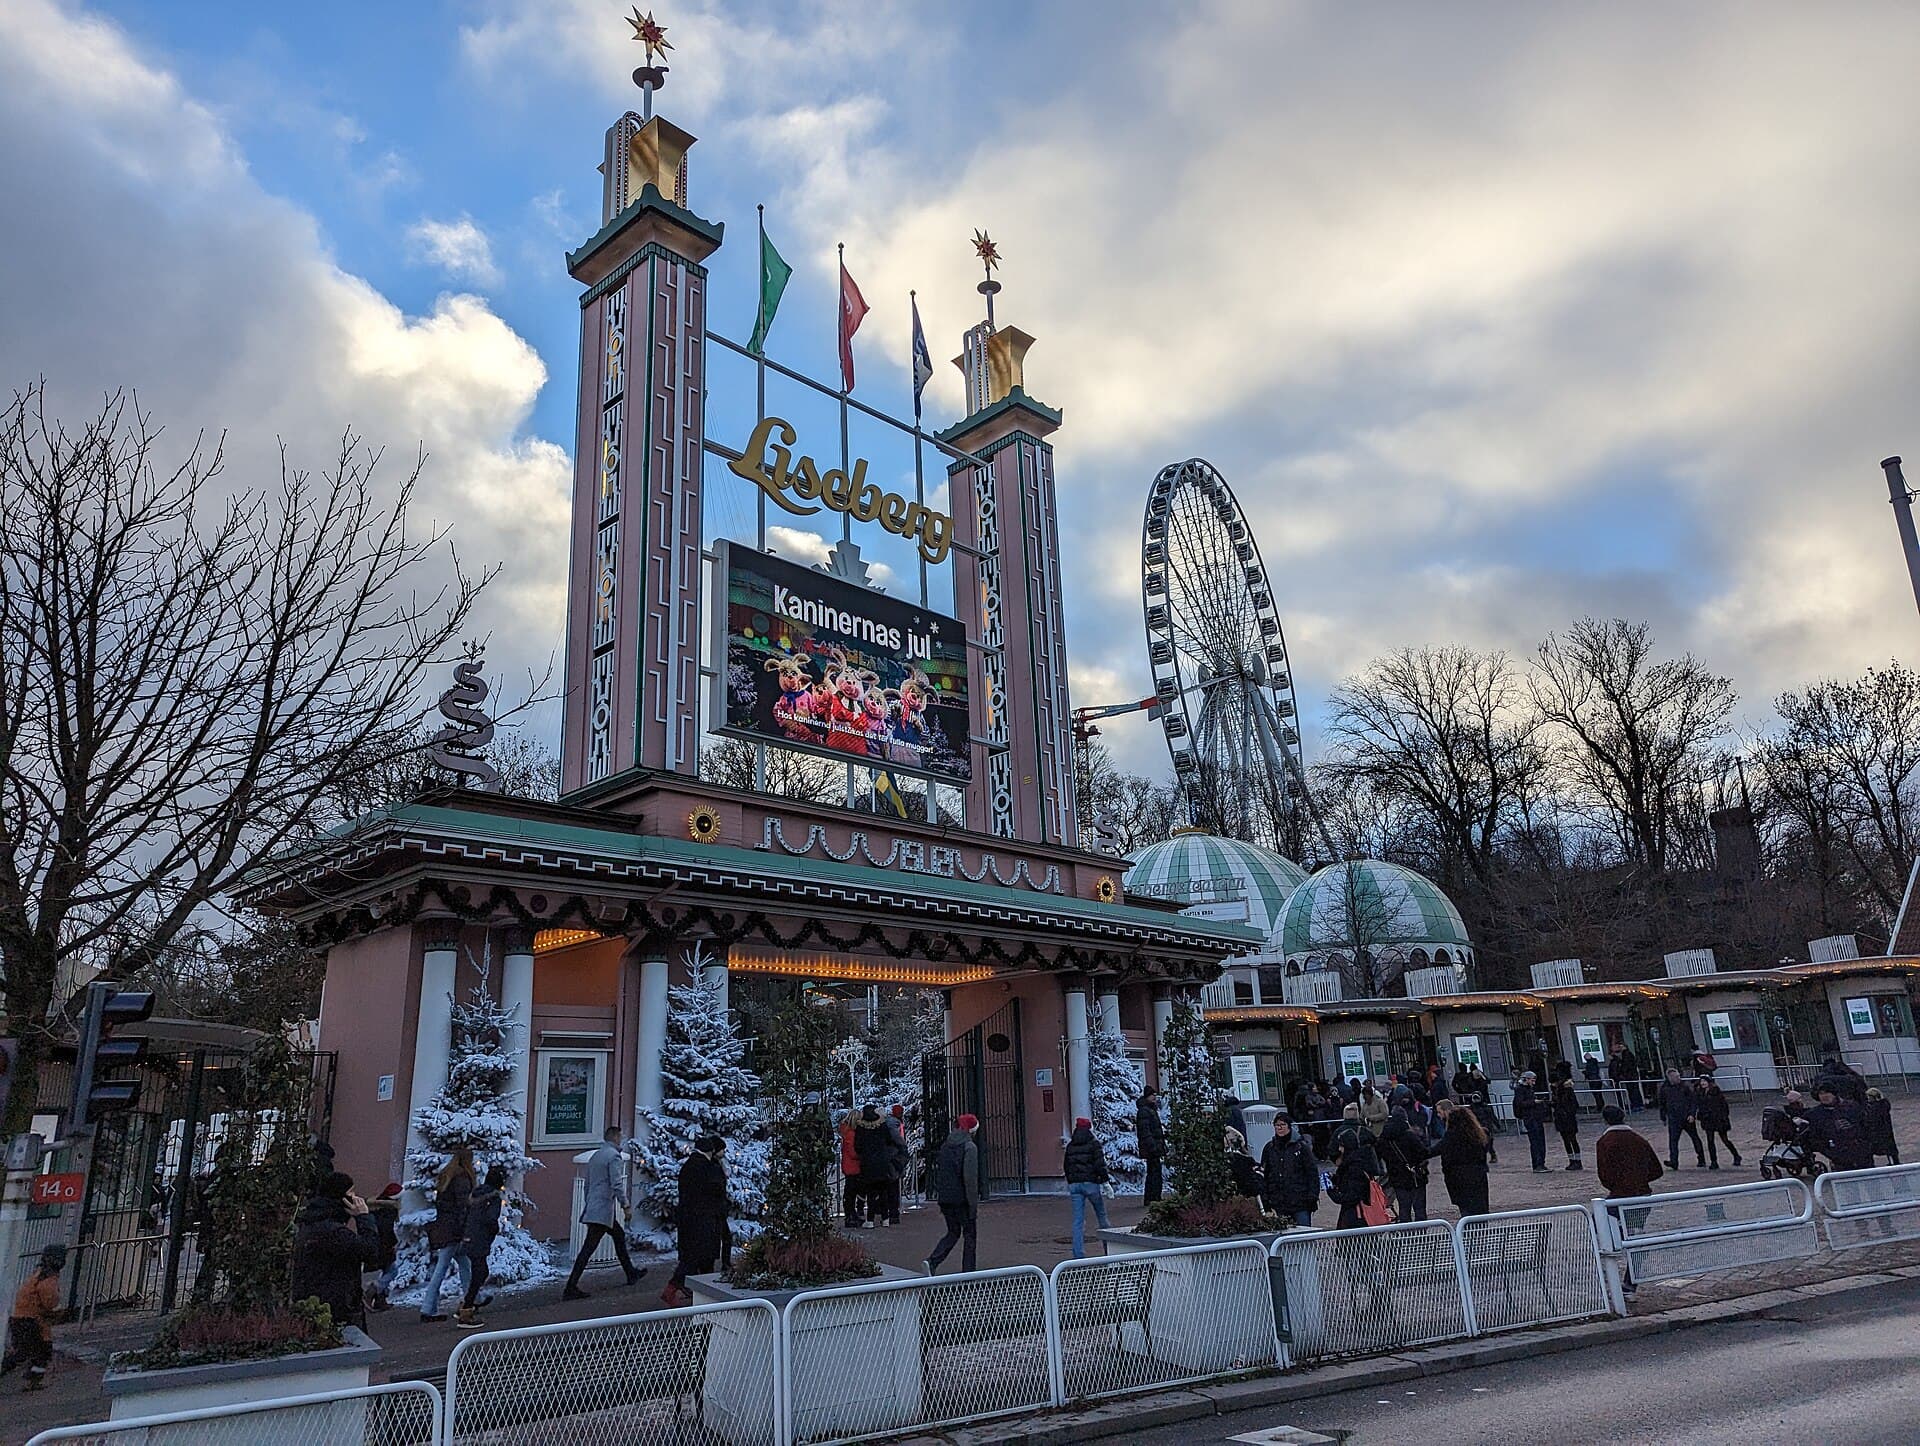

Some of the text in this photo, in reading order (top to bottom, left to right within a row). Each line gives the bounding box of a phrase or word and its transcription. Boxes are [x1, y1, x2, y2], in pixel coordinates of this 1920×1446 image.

[727, 416, 954, 564] Liseberg
[774, 584, 931, 660] Kaninernas jul
[777, 709, 793, 720] Hos
